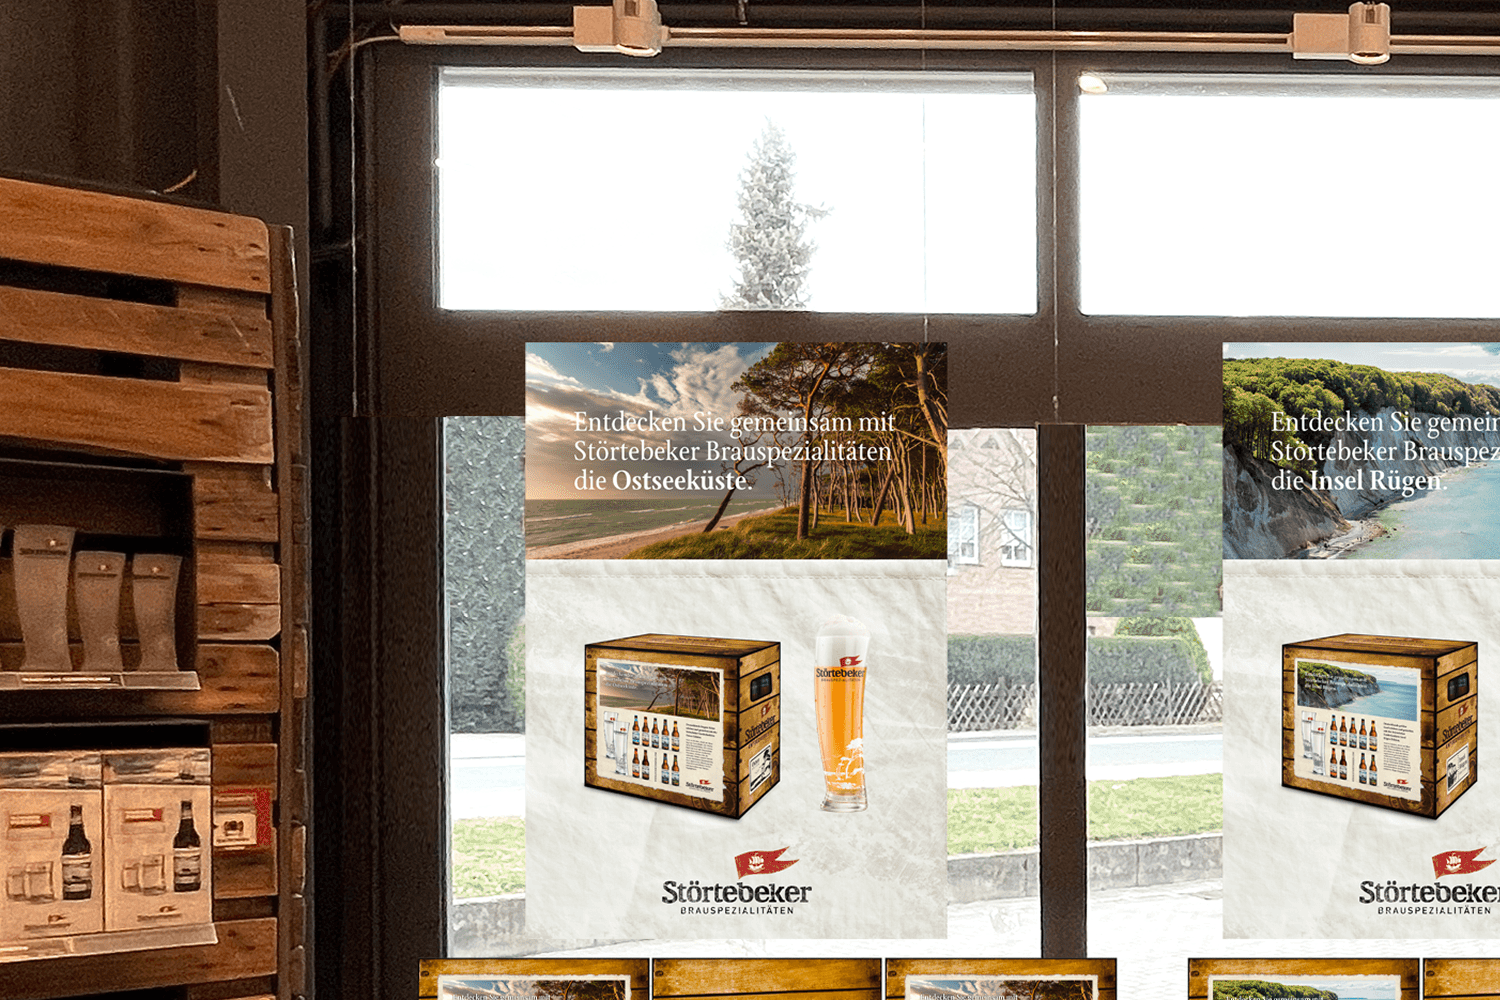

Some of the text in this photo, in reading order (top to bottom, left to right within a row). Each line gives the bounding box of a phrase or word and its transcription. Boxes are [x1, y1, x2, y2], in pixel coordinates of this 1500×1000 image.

[574, 411, 896, 438] Entdecken Sie gemeinsam mit
[1271, 411, 1383, 433] Entdecken
[1391, 411, 1421, 433] Sie
[574, 440, 892, 468] Störtebeker Brauspezialitäten
[1271, 440, 1396, 463] Störtebeker
[574, 469, 754, 491] die Ostseeküste.
[1271, 469, 1448, 497] die Insel Rügen.
[815, 668, 866, 679] Störtebeker
[661, 880, 812, 904] Störtebeker
[680, 903, 794, 915] BRAUSPEZIALITÄTEN
[1377, 903, 1491, 915] BRAUSPEZIALITÄTEN
